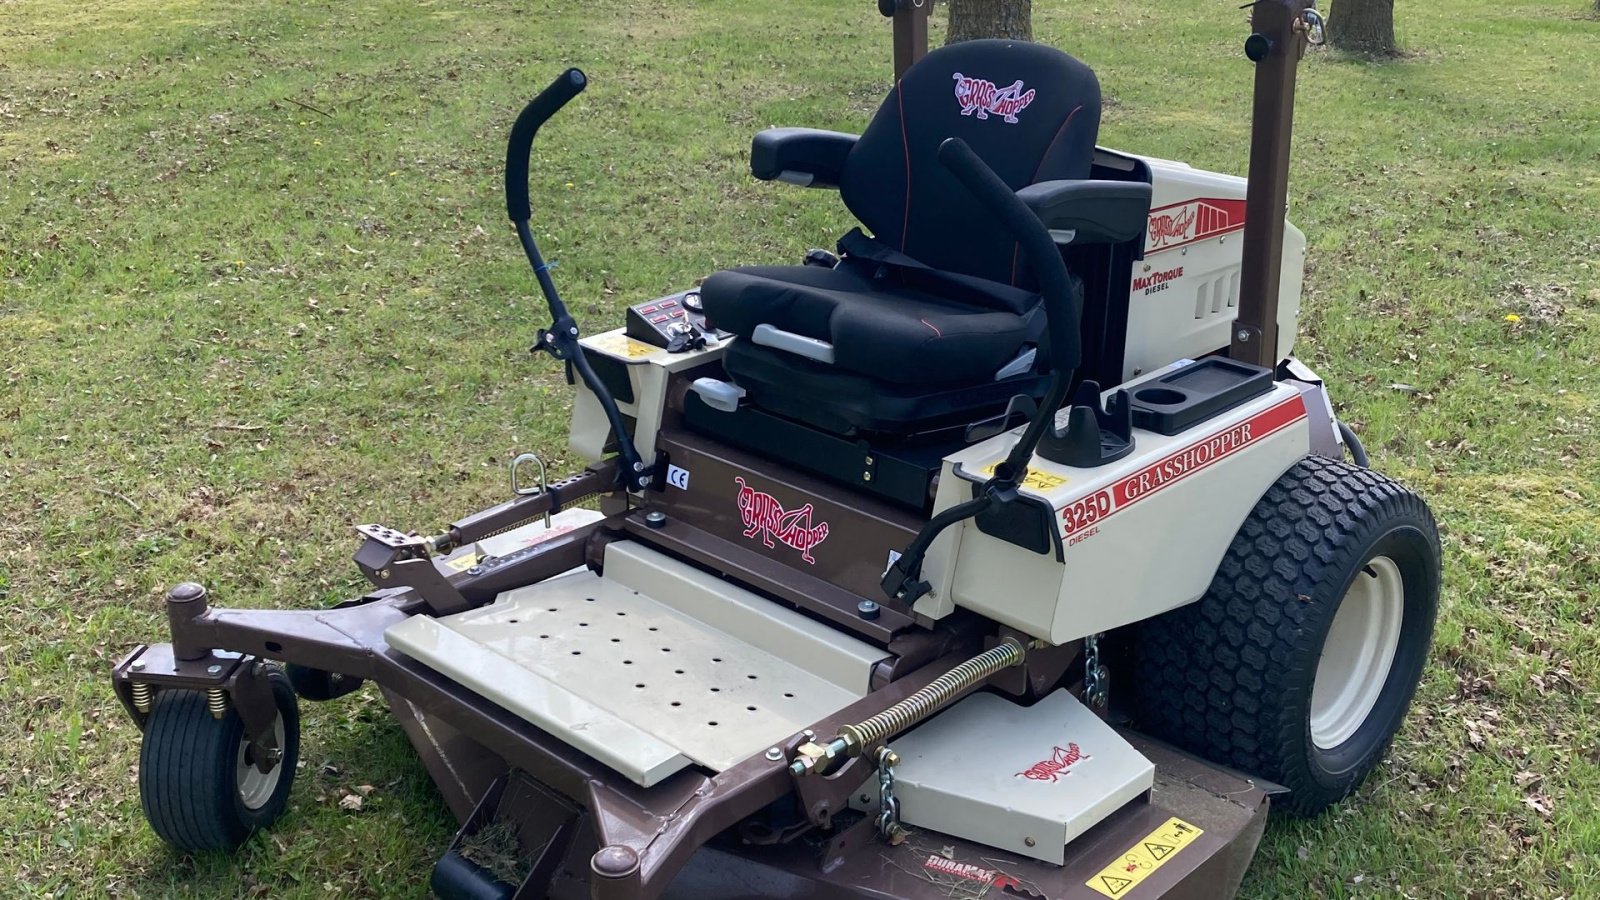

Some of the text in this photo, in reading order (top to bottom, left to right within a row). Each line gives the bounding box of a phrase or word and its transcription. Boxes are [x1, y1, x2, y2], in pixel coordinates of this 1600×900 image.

[1145, 282, 1169, 296] DIESEL
[1062, 423, 1252, 534] 325D GRASSHOPPER
[738, 483, 829, 555] GRASSHOPPER
[1069, 526, 1101, 547] DIESEL
